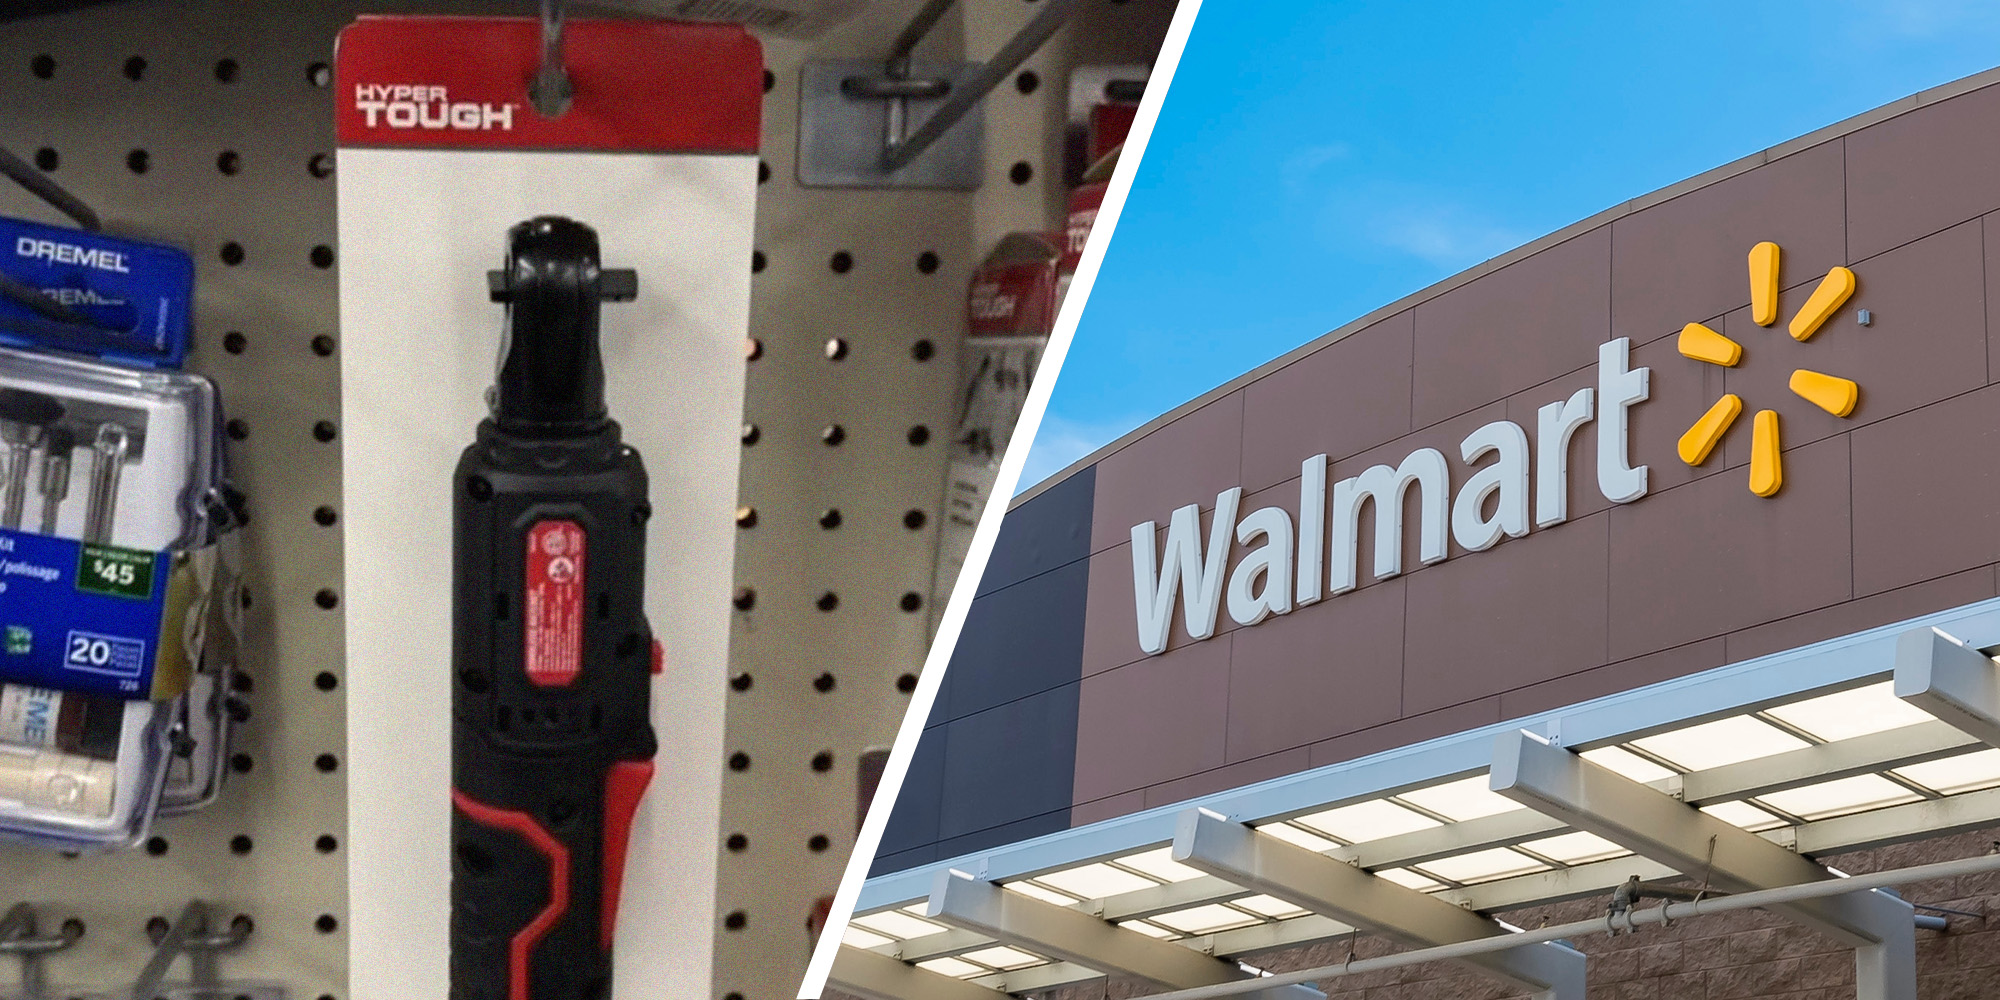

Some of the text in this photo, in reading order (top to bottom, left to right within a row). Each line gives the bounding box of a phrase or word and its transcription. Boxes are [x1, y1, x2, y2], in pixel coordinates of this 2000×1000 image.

[356, 83, 448, 102] HYPER
[356, 101, 513, 131] TOUGH
[16, 237, 130, 274] DREMEL
[1131, 337, 1650, 656] Walmart
[93, 559, 135, 586] $45
[70, 637, 110, 666] 20
